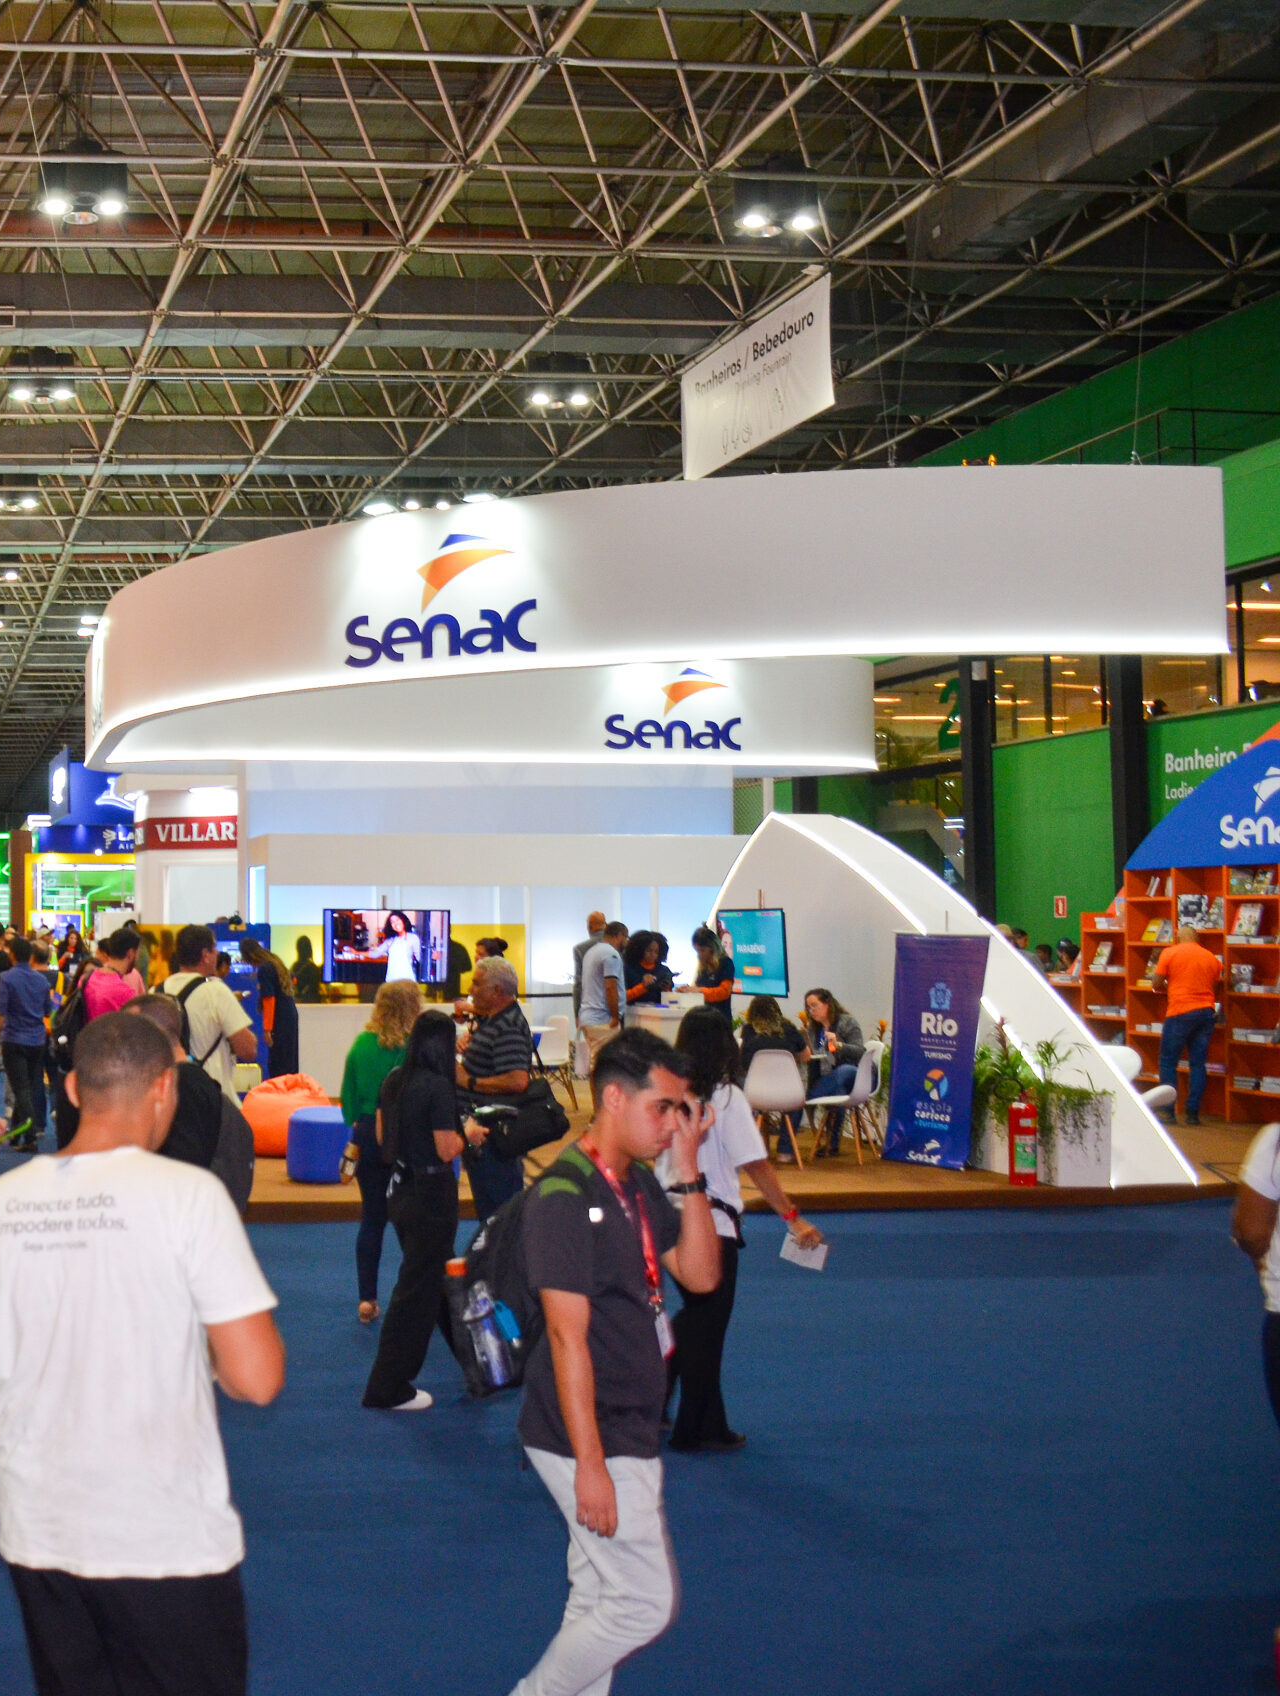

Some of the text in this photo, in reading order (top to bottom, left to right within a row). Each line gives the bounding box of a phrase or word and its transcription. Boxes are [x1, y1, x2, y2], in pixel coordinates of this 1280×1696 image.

[694, 358, 742, 396] Banheiros
[752, 311, 815, 361] Bebedouro
[1165, 746, 1238, 773] Banheiro
[1165, 781, 1199, 800] Ladie
[155, 822, 238, 842] VILLAR
[921, 1012, 958, 1037] Rio
[924, 1050, 952, 1061] TURISMO
[914, 1109, 950, 1123] carioca
[916, 1101, 952, 1113] escola
[5, 1197, 72, 1213] Conecte
